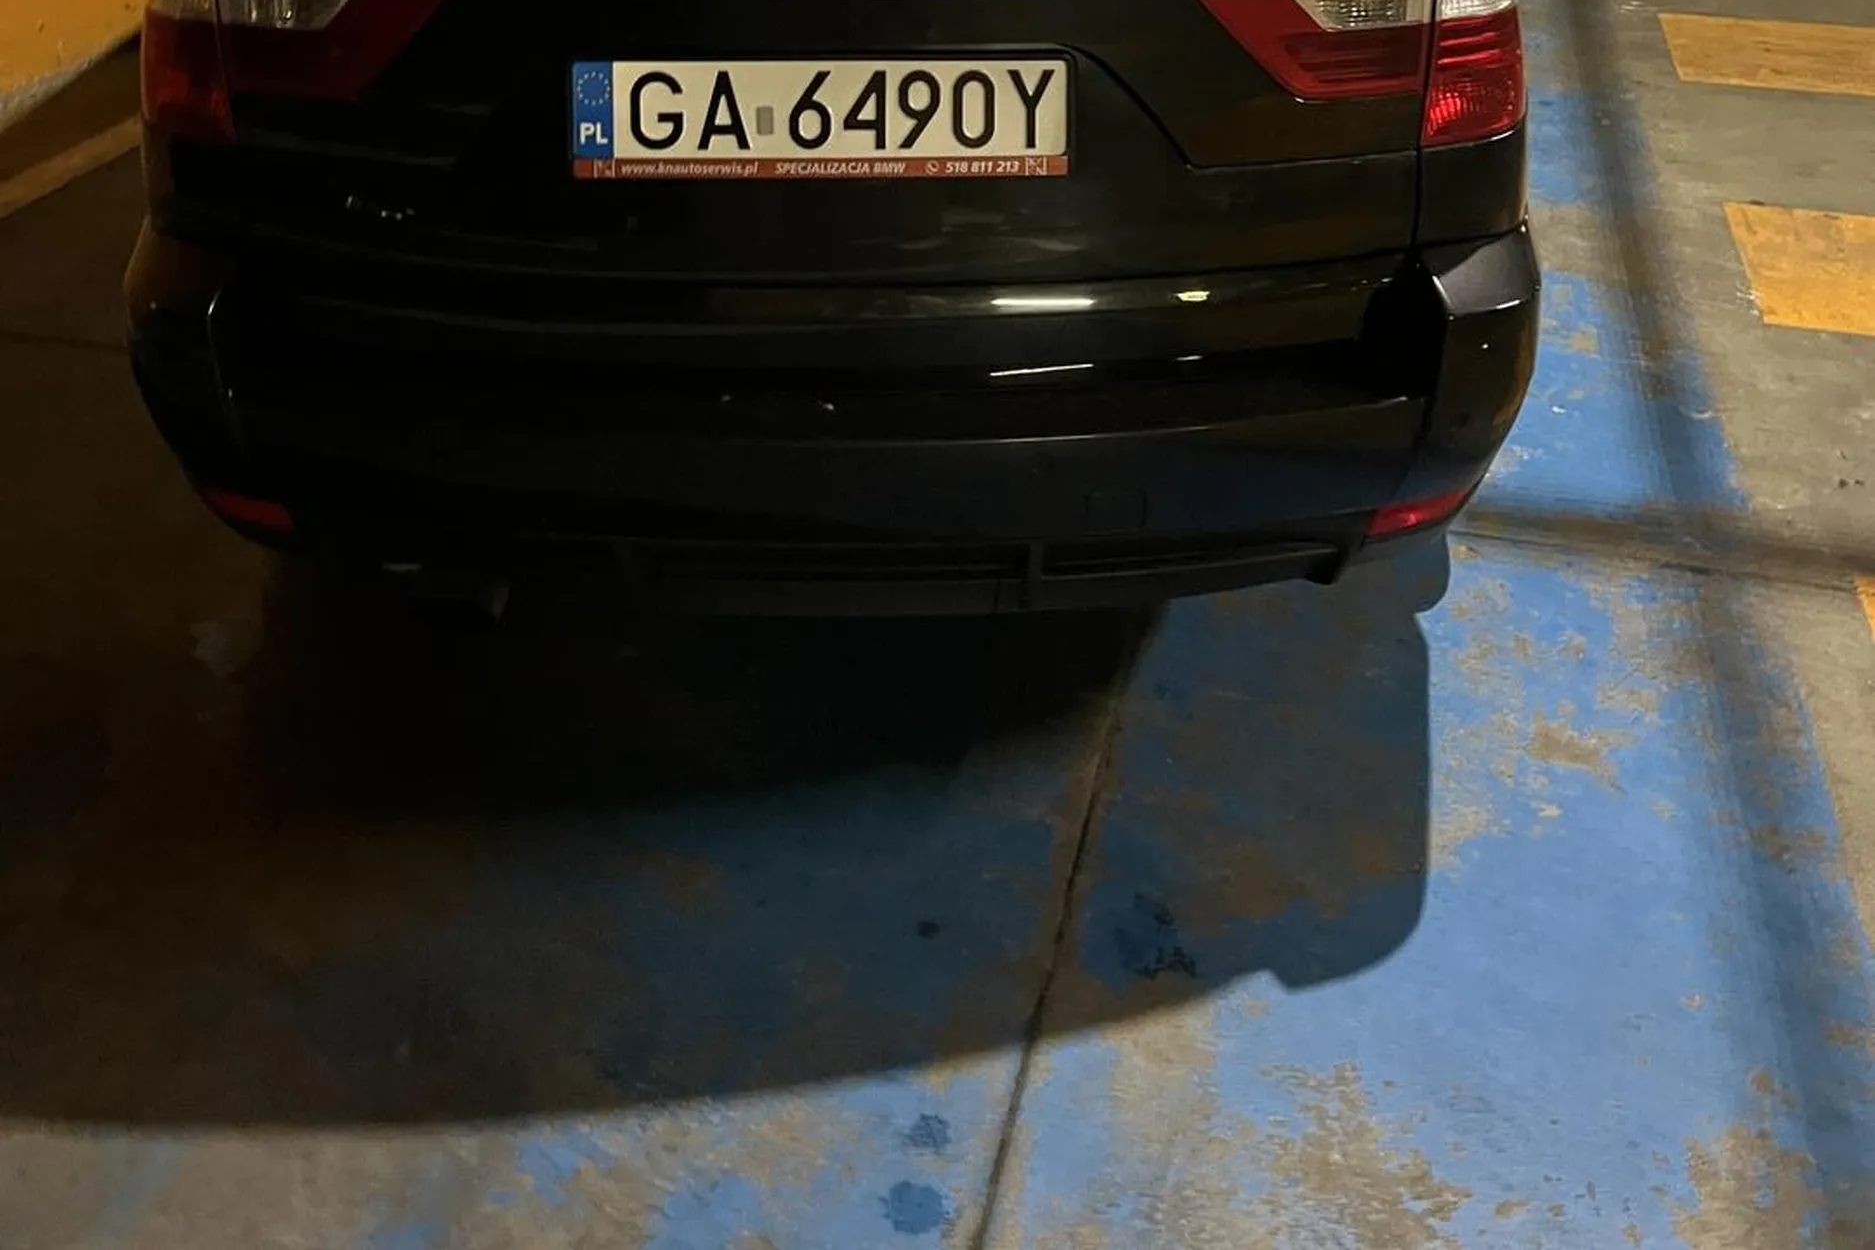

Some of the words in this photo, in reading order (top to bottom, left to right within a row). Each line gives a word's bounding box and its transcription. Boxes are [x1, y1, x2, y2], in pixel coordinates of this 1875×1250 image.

[629, 69, 752, 151] GA
[788, 68, 1055, 151] 6490Y
[580, 122, 609, 146] PL
[621, 161, 759, 177] www.knautoserwis.pl
[774, 160, 871, 176] SPECJALIZACJA
[874, 160, 905, 175] BMW
[945, 159, 968, 174] 518
[971, 159, 993, 174] 811
[996, 159, 1020, 174] 213
